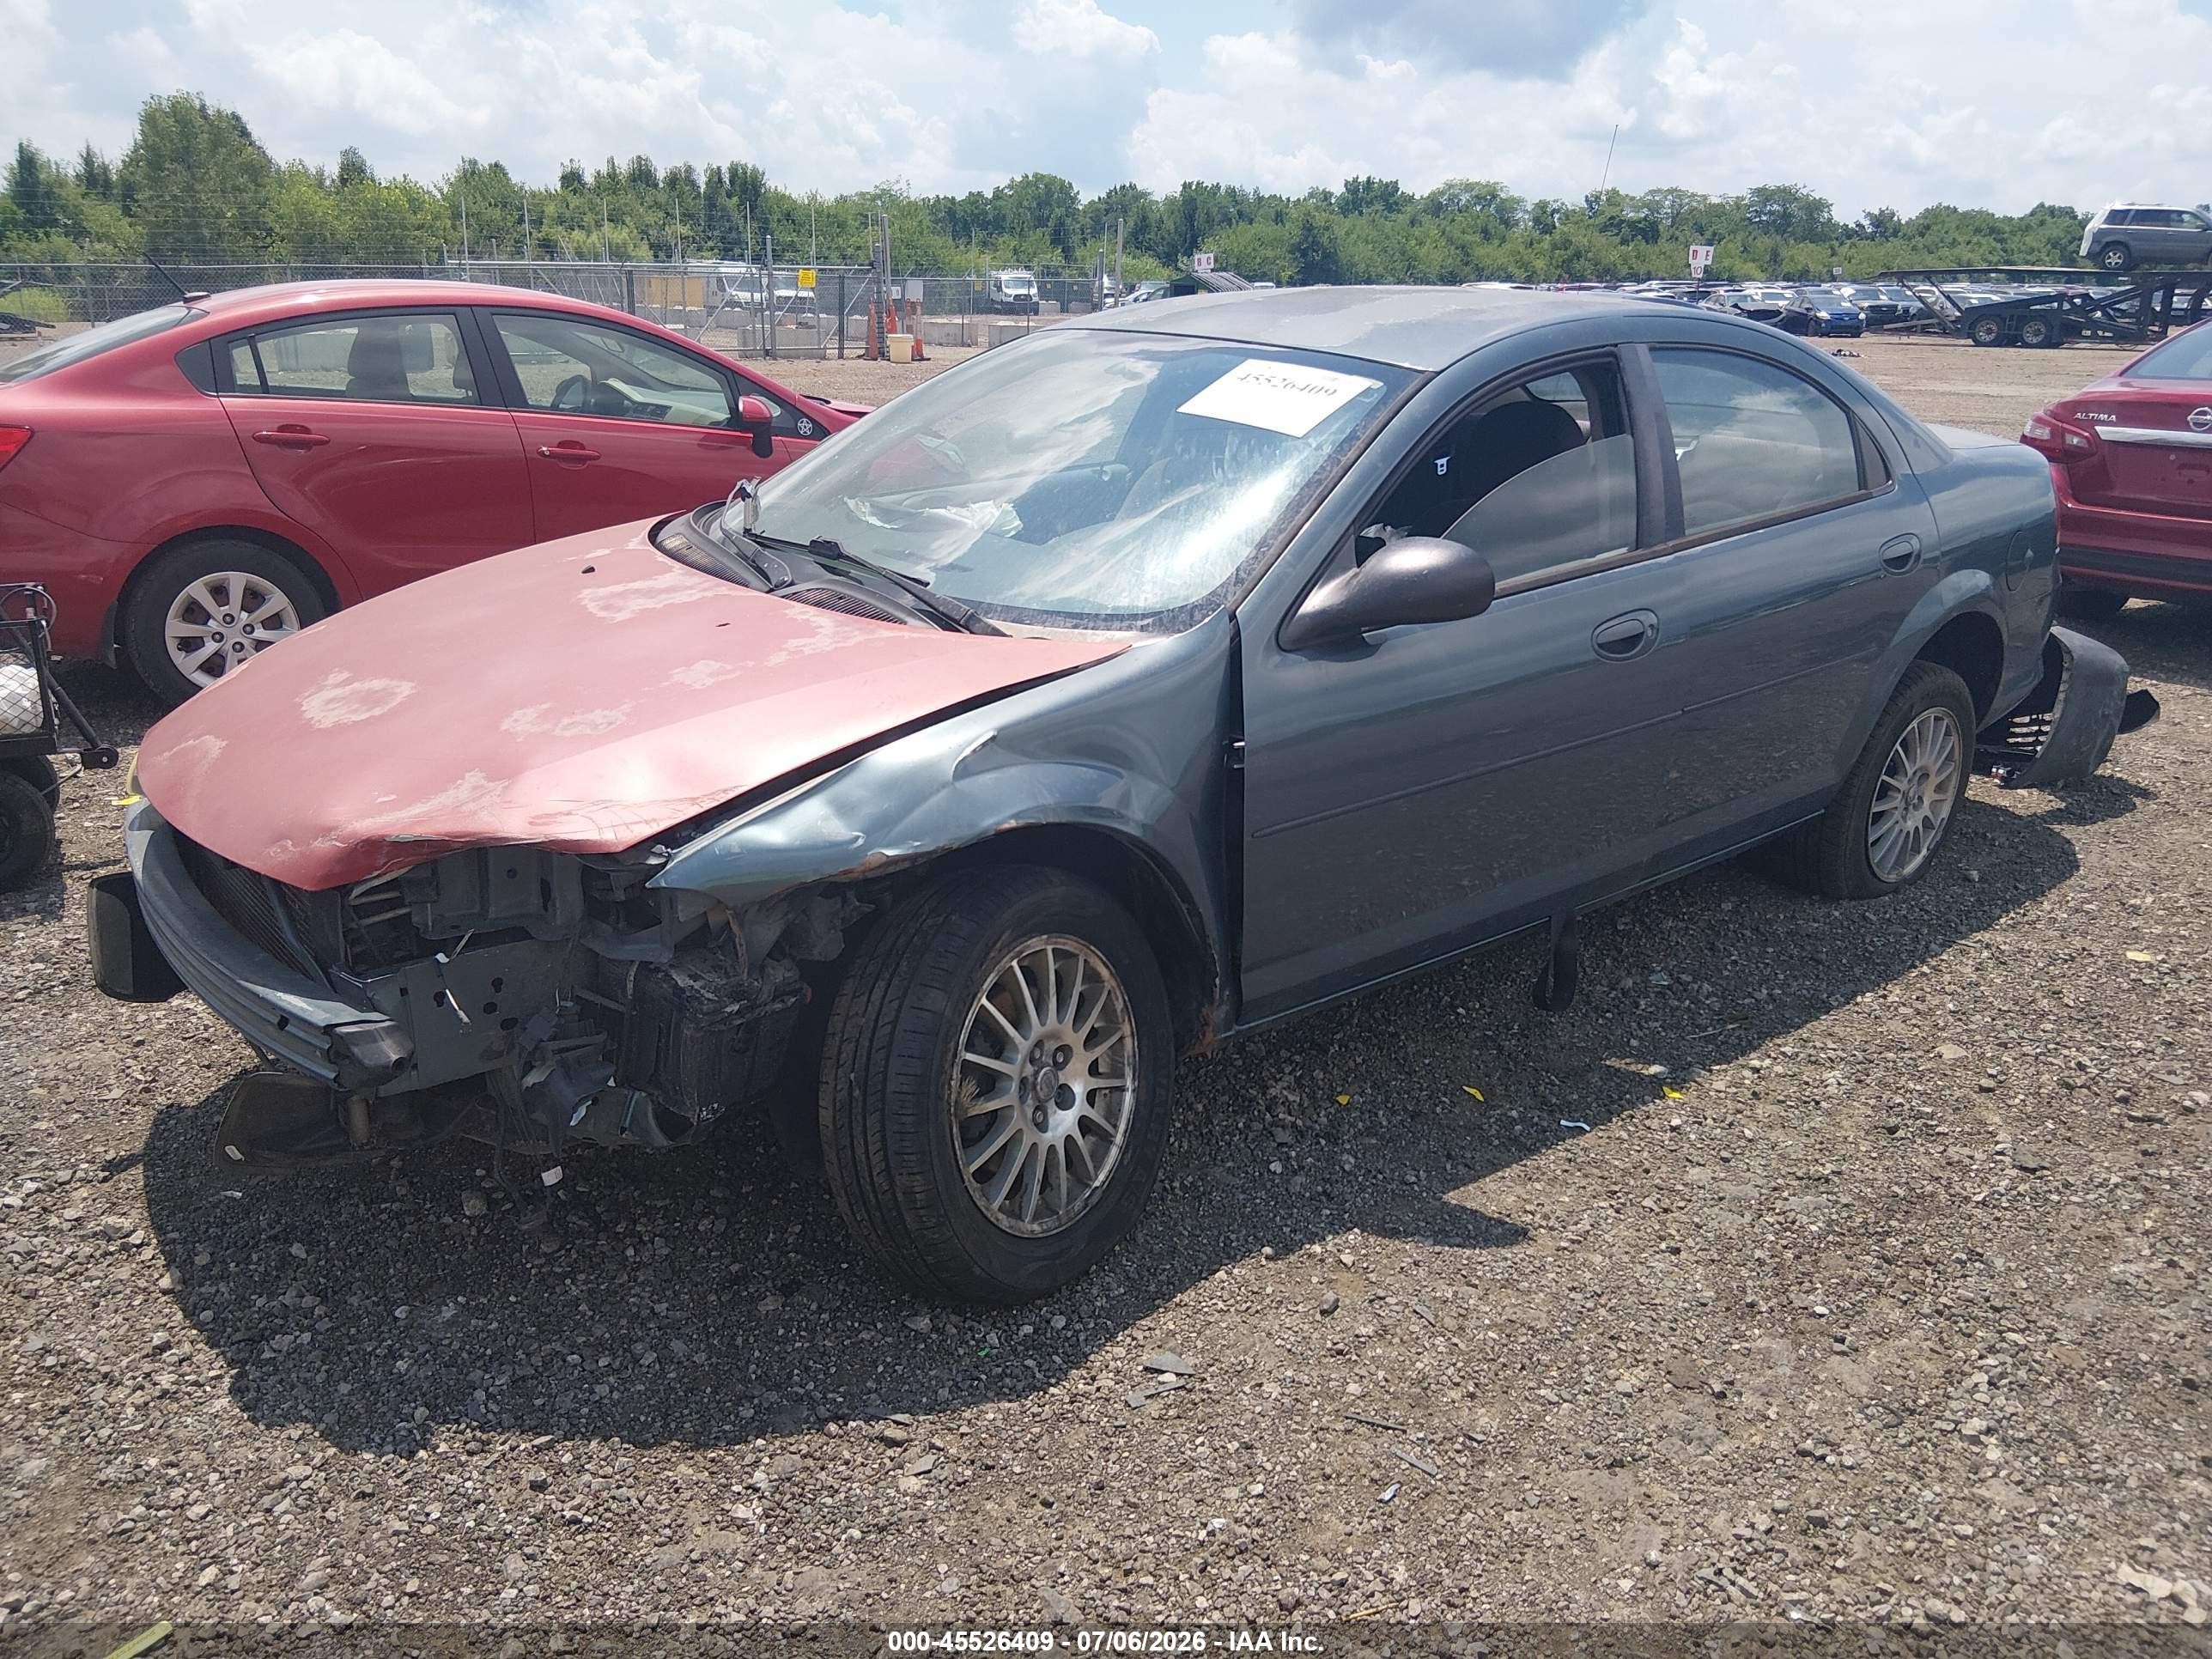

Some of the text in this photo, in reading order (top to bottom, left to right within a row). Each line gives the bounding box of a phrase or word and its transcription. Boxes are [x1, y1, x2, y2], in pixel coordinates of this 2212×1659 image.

[1692, 249, 1711, 261] D E
[1692, 265, 1703, 276] 10
[2074, 412, 2117, 422] ALTIMA
